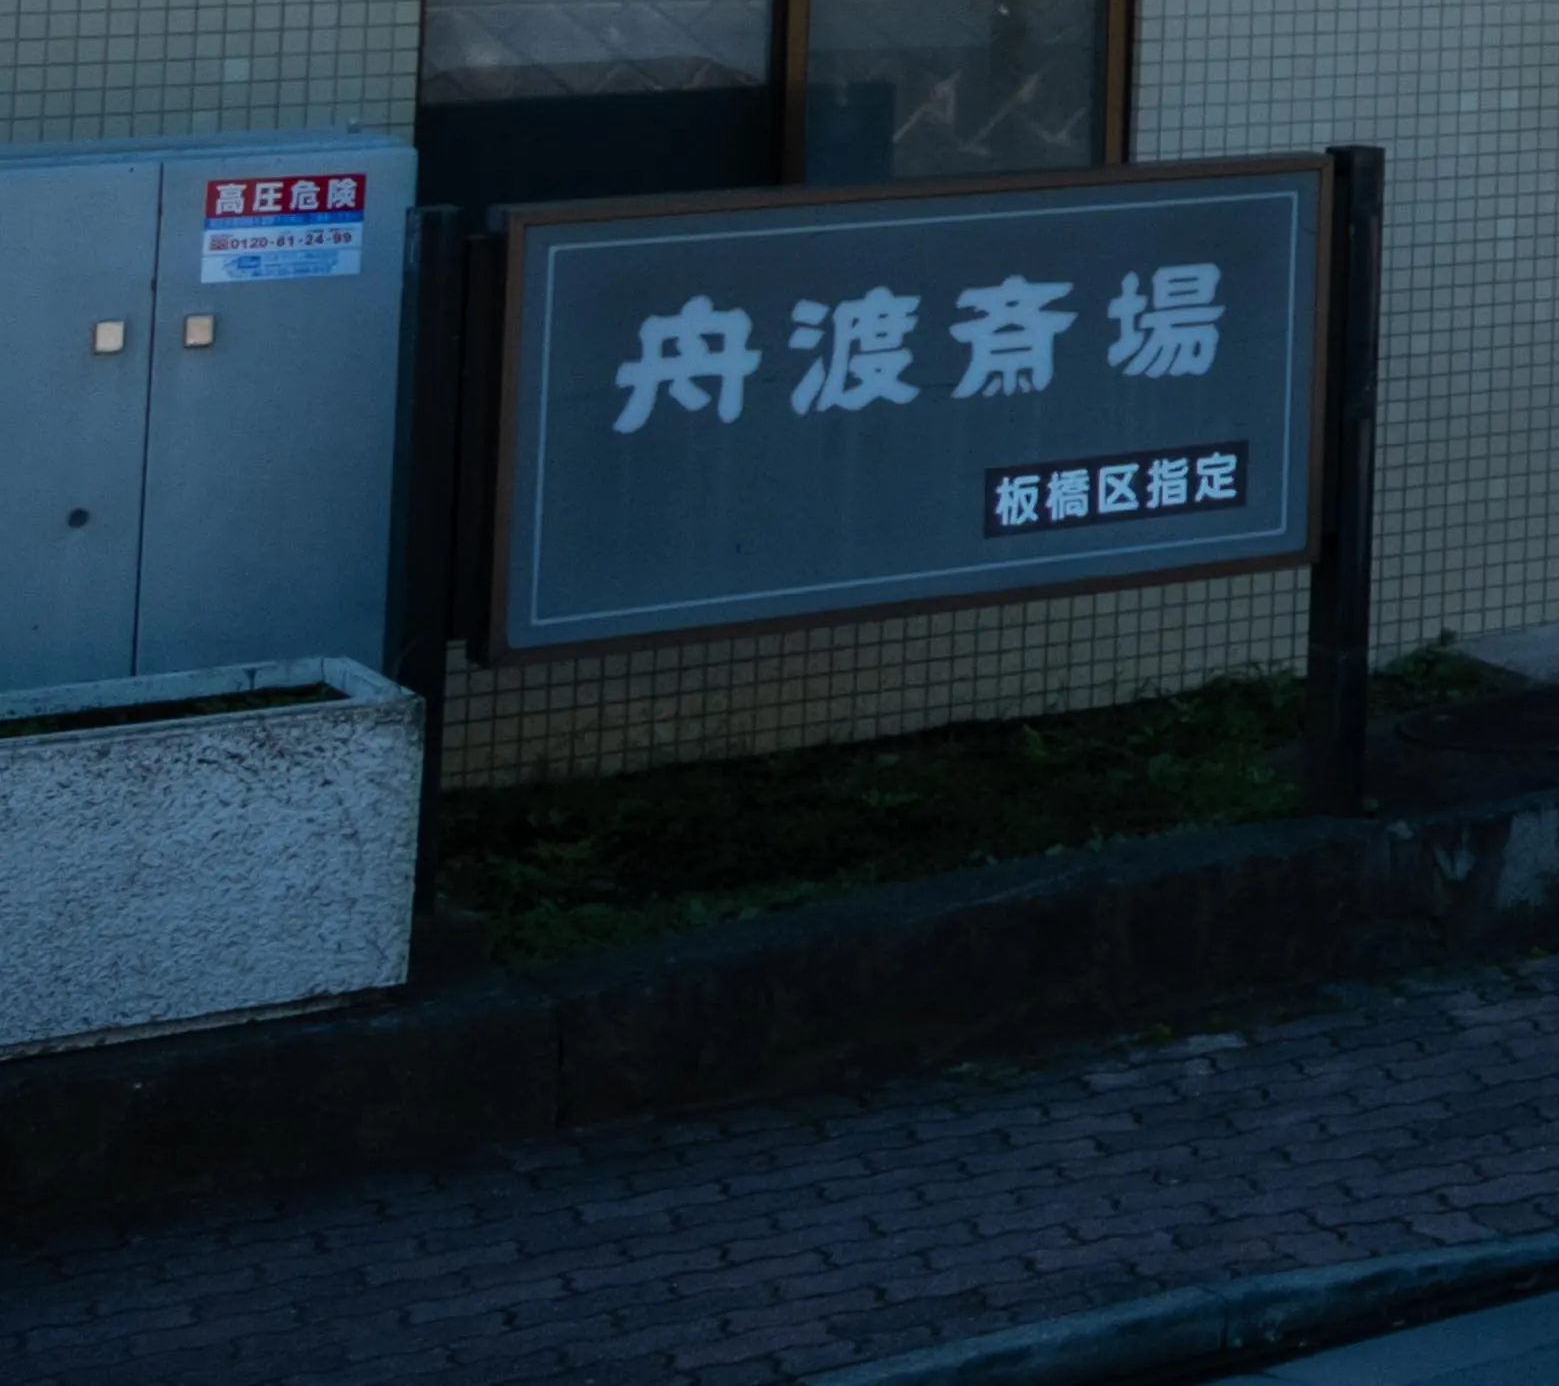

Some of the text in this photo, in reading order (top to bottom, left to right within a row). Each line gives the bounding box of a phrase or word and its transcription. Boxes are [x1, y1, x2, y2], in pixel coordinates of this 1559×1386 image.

[215, 177, 358, 216] 高圧危険
[612, 262, 1226, 434] 舟渡斎場
[995, 452, 1239, 526] 板橋区指定
